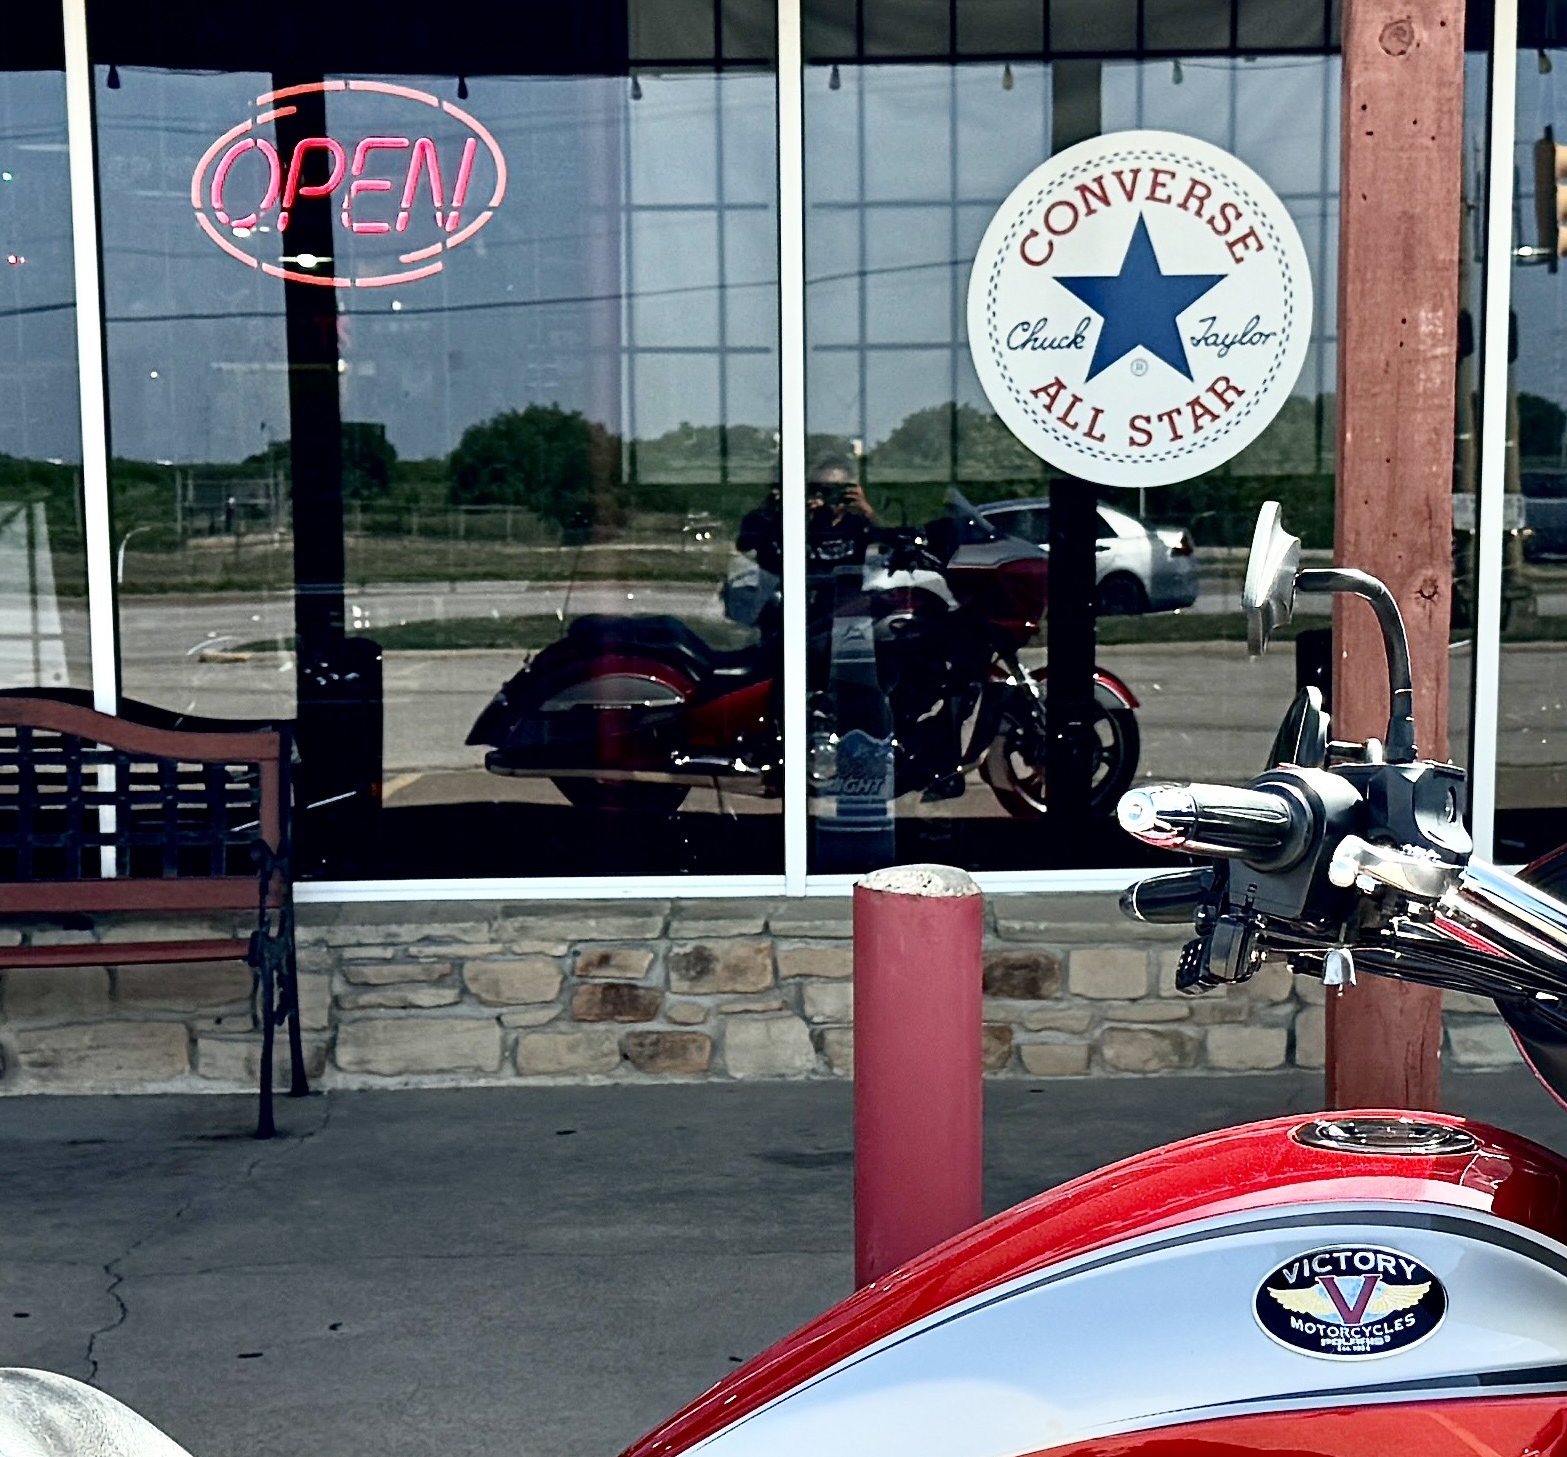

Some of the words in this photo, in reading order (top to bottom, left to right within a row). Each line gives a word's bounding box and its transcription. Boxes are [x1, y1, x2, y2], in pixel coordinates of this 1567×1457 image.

[211, 135, 477, 236] OPEN
[1019, 167, 1265, 268] CONVERSE
[1006, 316, 1092, 351] Chuck
[1189, 316, 1278, 359] Taylor
[1030, 375, 1107, 445] ALL
[1128, 373, 1246, 448] STAR
[1283, 1251, 1417, 1284] VICTORY
[1290, 1313, 1417, 1338] MOTORCYCLES
